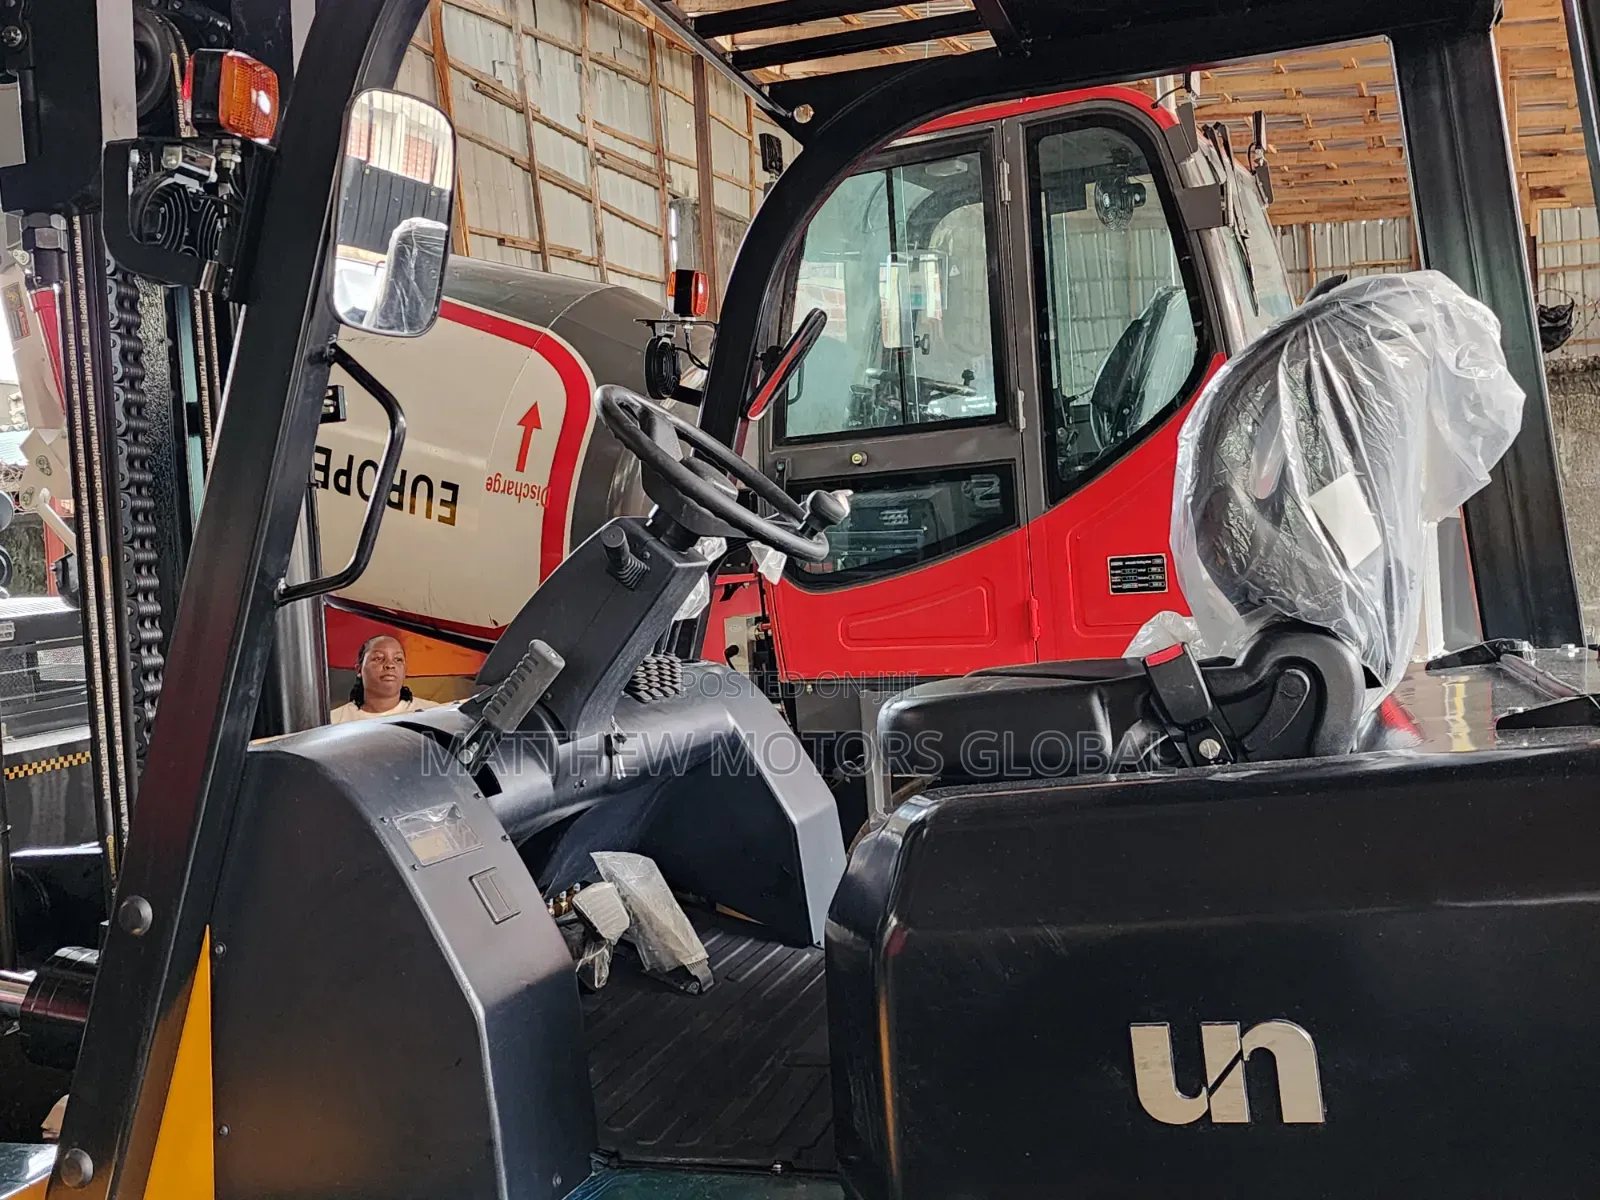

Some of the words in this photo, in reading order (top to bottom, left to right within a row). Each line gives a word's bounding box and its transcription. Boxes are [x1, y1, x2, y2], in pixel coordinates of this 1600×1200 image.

[76, 267, 84, 286] W.P.
[78, 290, 88, 322] 5000PSI
[84, 352, 92, 381] FLAME
[195, 305, 203, 335] 5000PSI
[202, 390, 210, 433] RESISTANT
[86, 385, 96, 432] RESISTANT
[91, 436, 99, 461] MSHA
[314, 445, 459, 526] EUROPE
[485, 473, 550, 508] Discharge
[84, 544, 92, 563] W.P.
[92, 628, 100, 658] FLAME
[94, 662, 106, 710] RESISTANT
[98, 714, 107, 739] MSHA
[116, 744, 124, 761] 2SC
